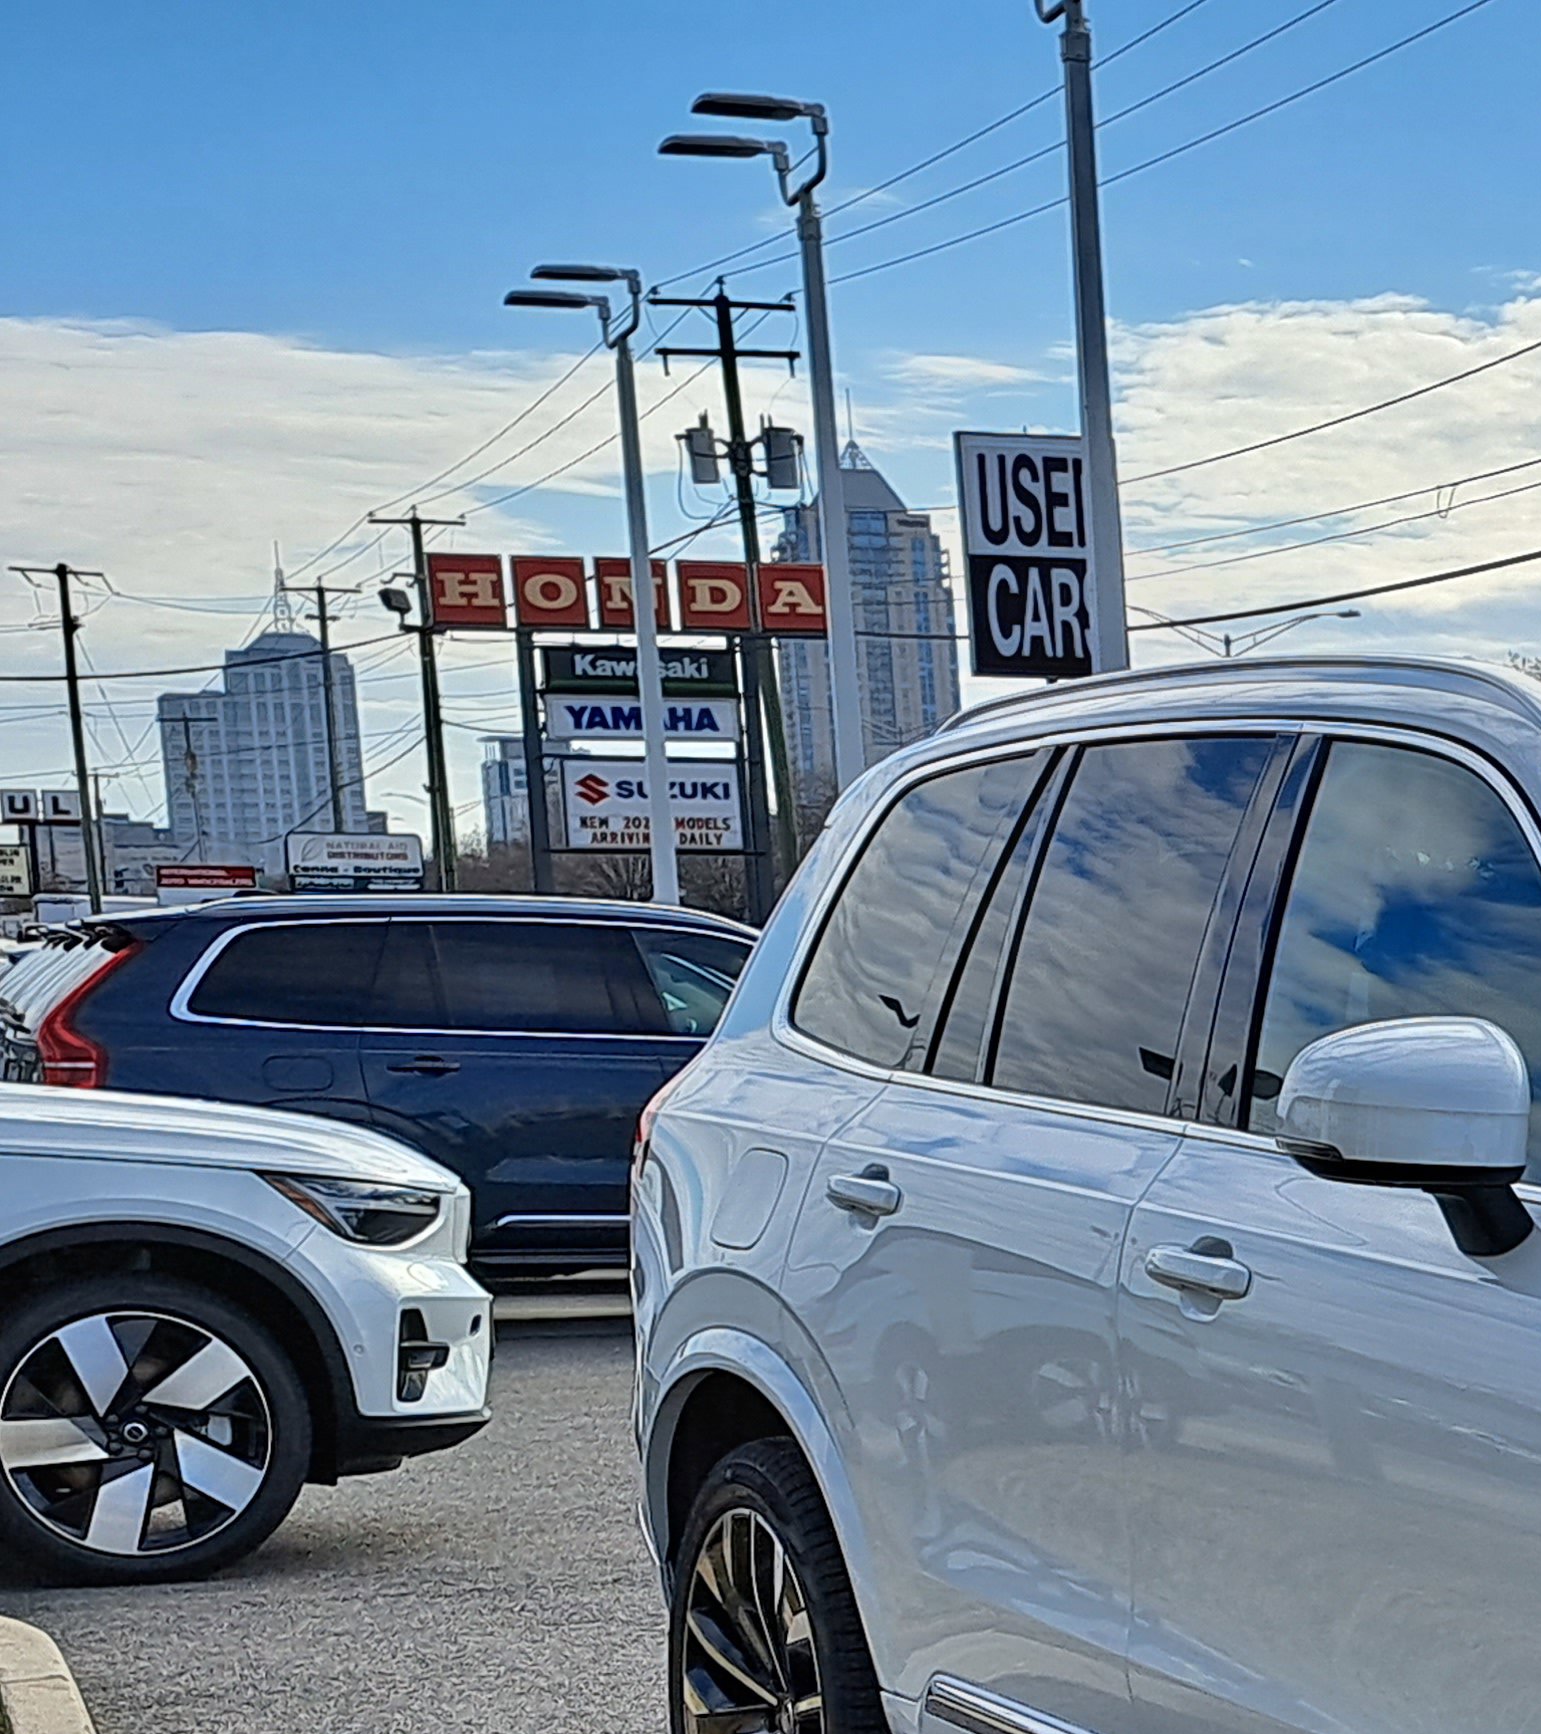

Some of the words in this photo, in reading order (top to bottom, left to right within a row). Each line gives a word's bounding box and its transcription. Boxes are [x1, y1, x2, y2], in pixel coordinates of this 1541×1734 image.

[987, 563, 1090, 659] CAR
[573, 654, 710, 679] Kawsaki
[563, 704, 720, 732] YAMHA
[623, 816, 650, 830] 202
[675, 817, 731, 832] MODELS
[590, 832, 651, 845] ARRIVIN
[679, 833, 723, 846] DAILY
